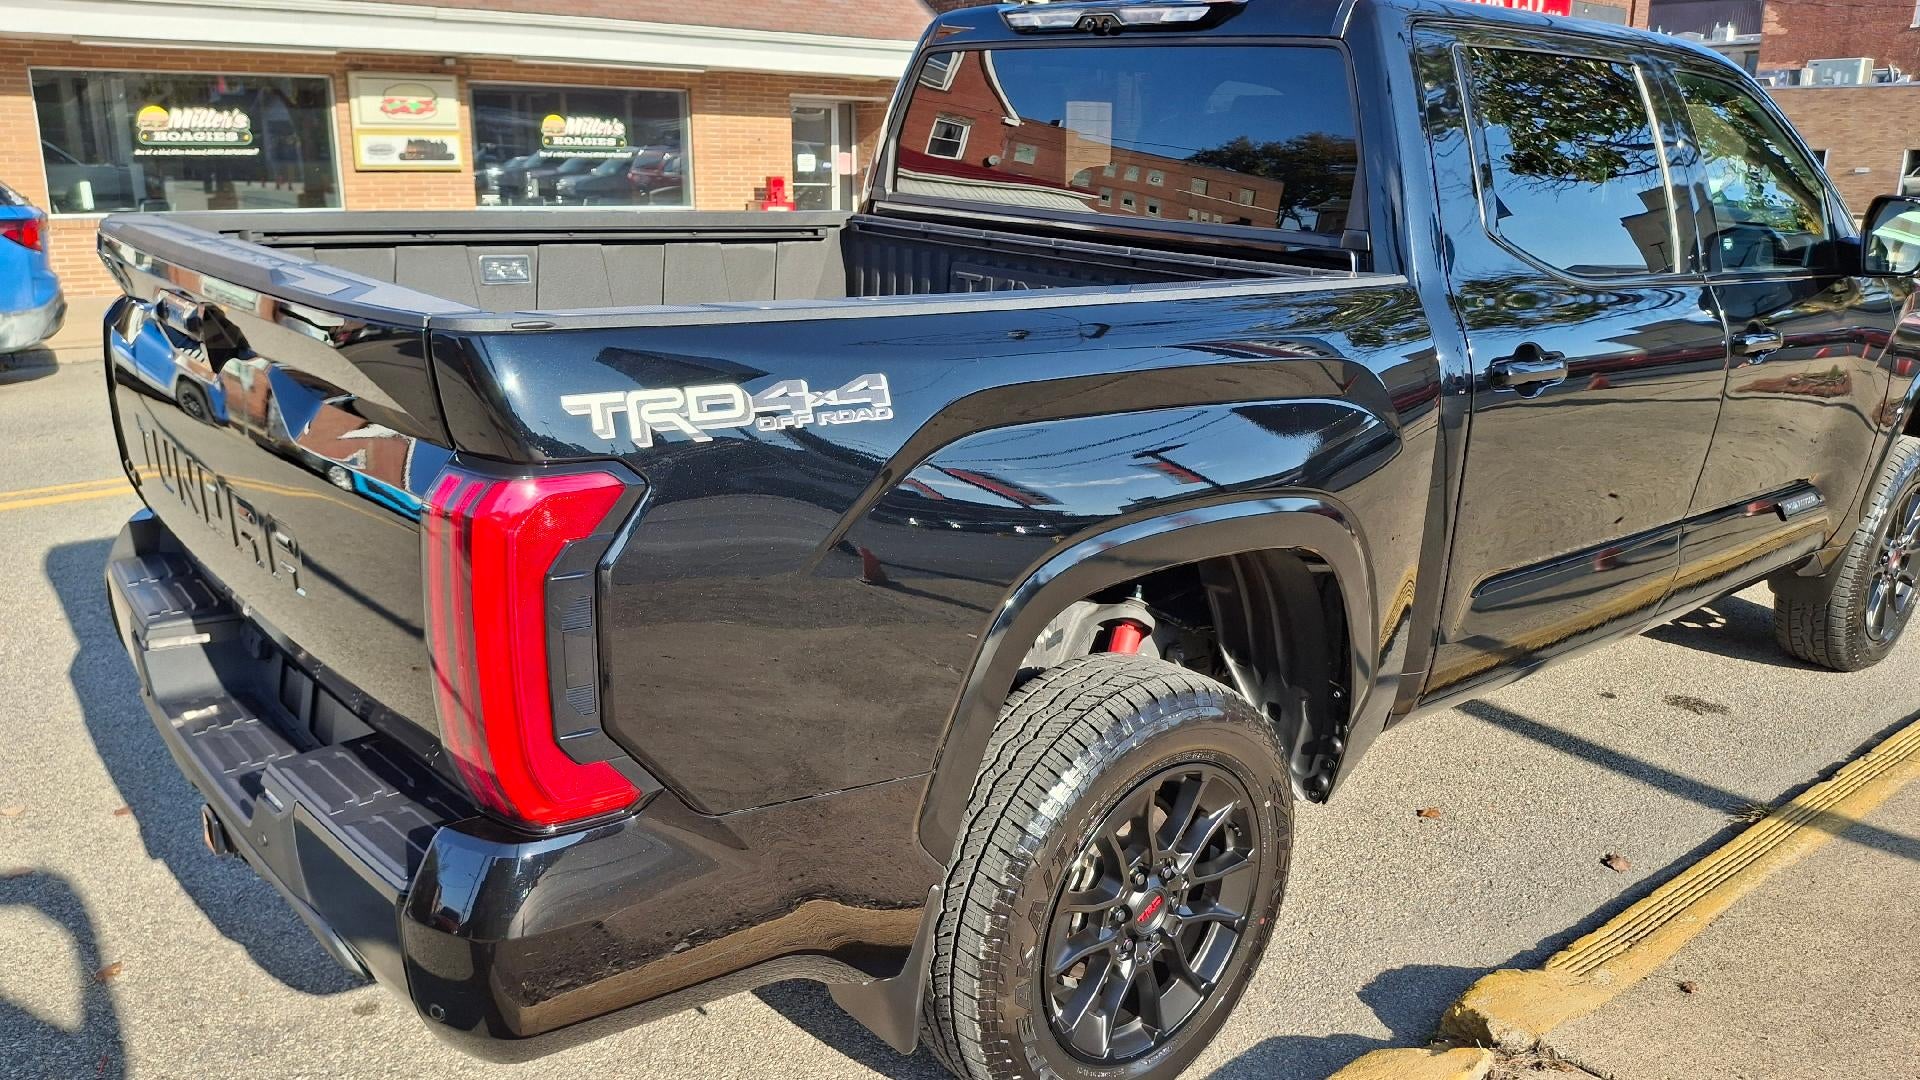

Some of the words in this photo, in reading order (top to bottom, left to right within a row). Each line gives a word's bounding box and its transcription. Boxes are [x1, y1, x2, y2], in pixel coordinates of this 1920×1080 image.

[168, 107, 250, 129] Miller's
[565, 116, 625, 136] Miller's
[153, 131, 239, 142] HOAGIES
[552, 136, 617, 146] HOAGIES
[560, 383, 754, 449] TRD
[752, 373, 893, 414] 4x4
[755, 411, 814, 432] OFF
[817, 406, 894, 426] ROAD
[134, 410, 308, 597] TUNDRA
[1136, 894, 1164, 923] TRD
